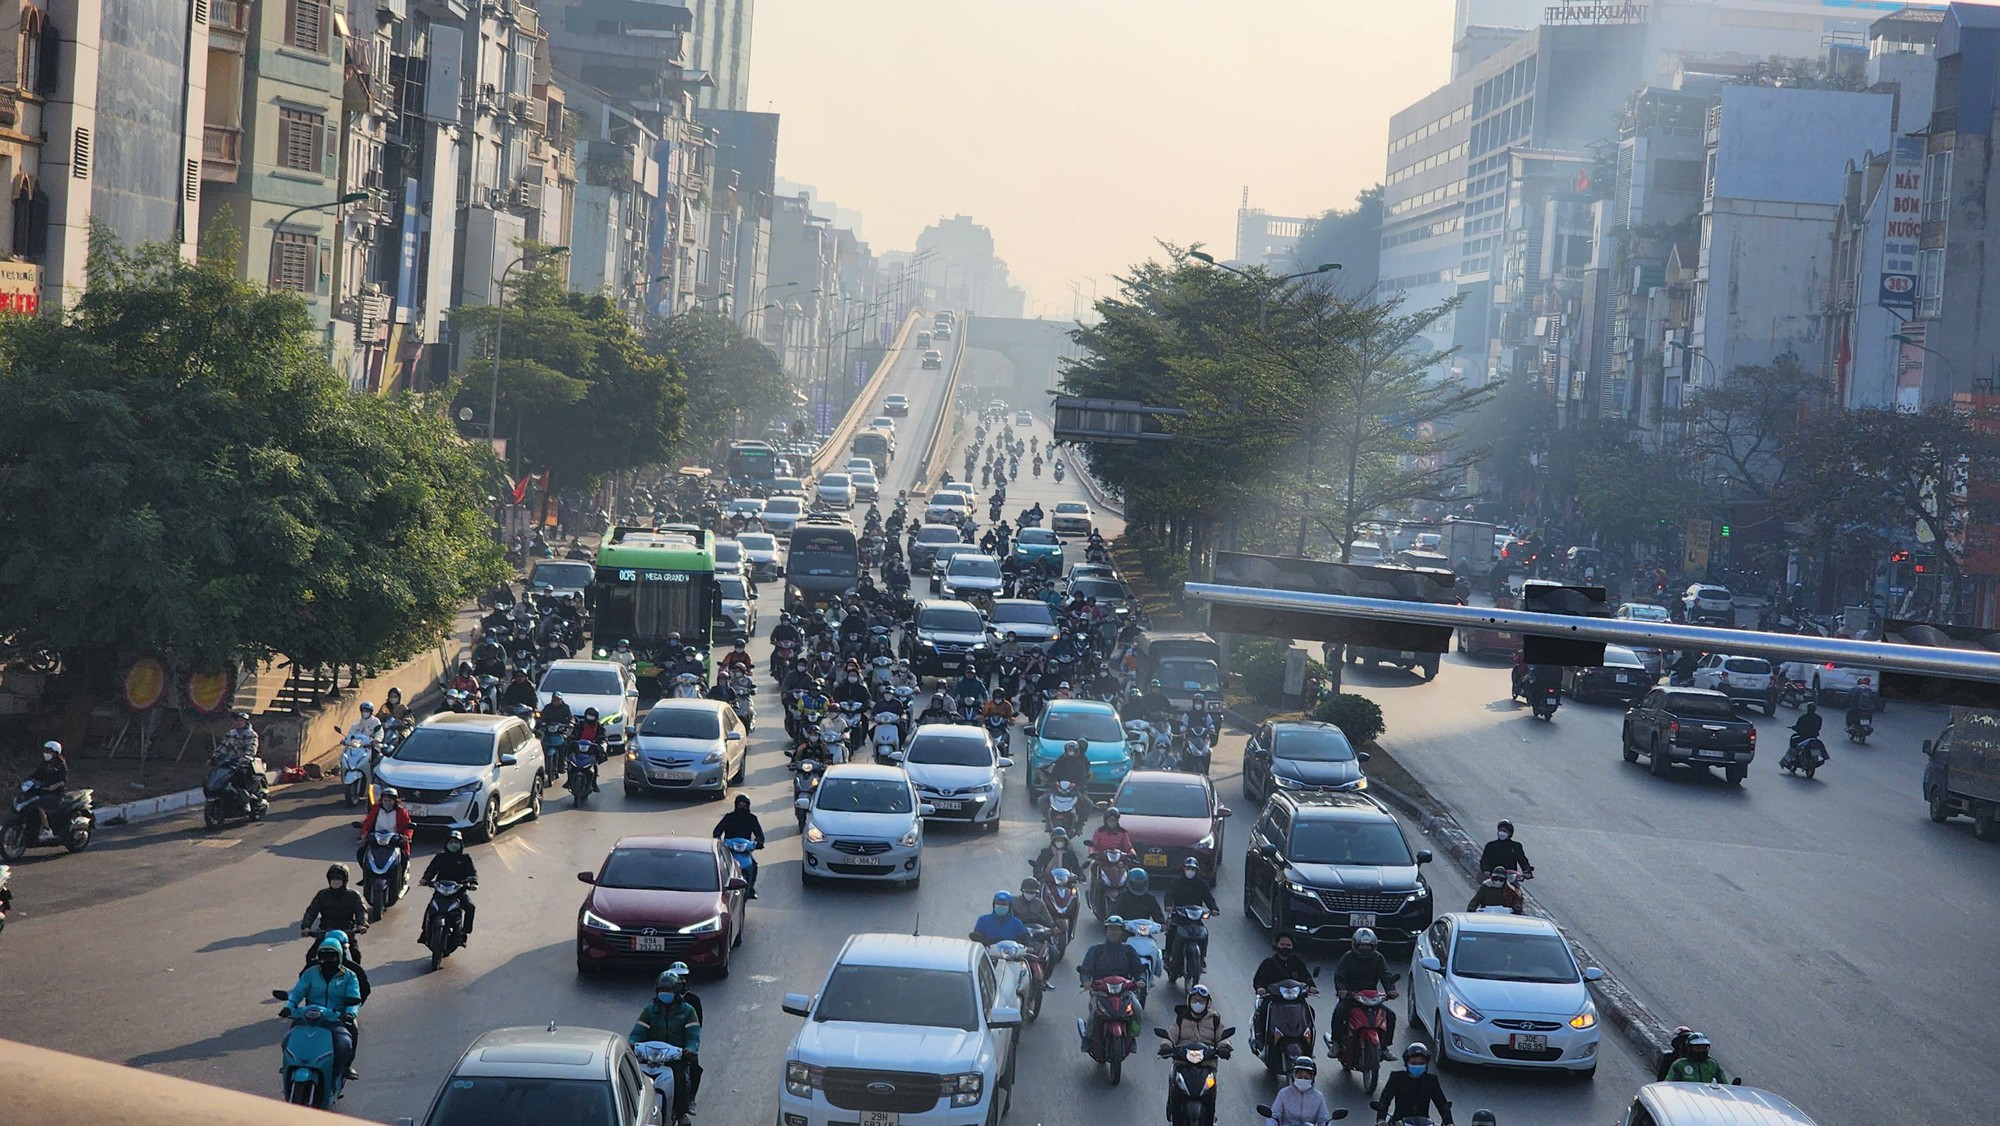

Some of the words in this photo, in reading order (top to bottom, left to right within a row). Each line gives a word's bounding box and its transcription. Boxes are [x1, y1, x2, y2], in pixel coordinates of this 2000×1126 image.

[1895, 169, 1920, 190] MÁY
[1893, 196, 1920, 213] BƠM
[1888, 217, 1921, 238] NƯỚC
[645, 572, 663, 581] MEGA
[663, 573, 685, 582] GRAND
[871, 1112, 888, 1121] 29H
